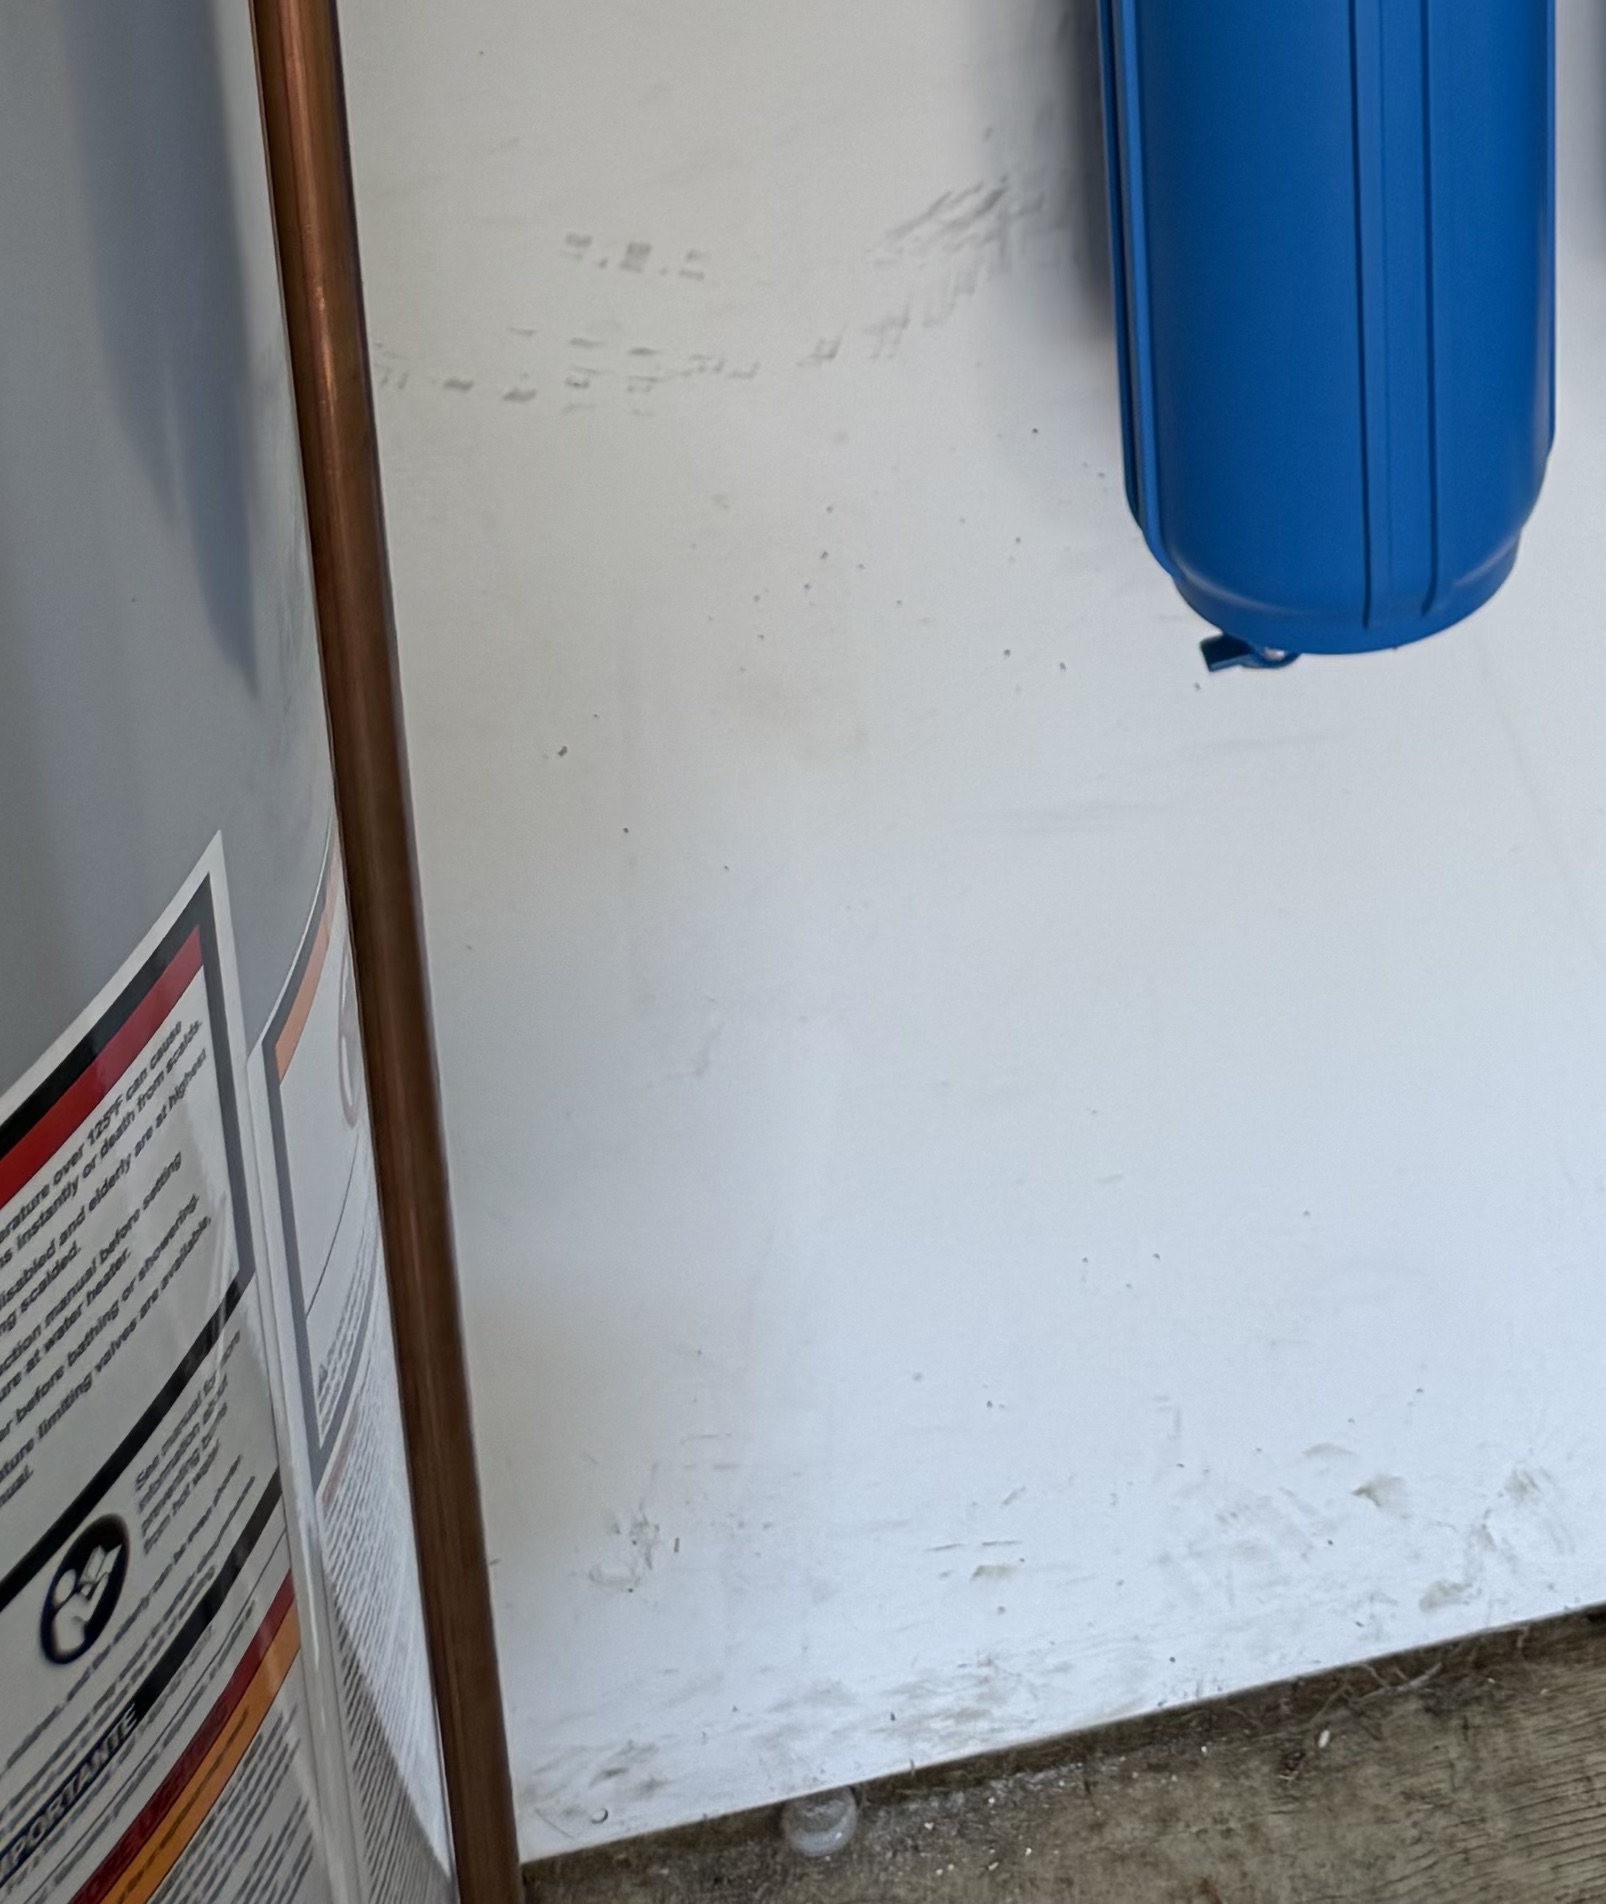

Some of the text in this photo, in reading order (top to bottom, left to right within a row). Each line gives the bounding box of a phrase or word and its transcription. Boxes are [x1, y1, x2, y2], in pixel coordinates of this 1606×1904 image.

[17, 1175, 79, 1249] instantly
[83, 1158, 98, 1179] or
[100, 1110, 136, 1160] death
[138, 1070, 165, 1113] from
[53, 1143, 85, 1186] over
[87, 1094, 122, 1146] 125°F
[126, 1068, 147, 1101] can
[150, 1020, 182, 1069] cause
[59, 1206, 86, 1248] and
[89, 1153, 132, 1211] elderly
[135, 1126, 153, 1158] are
[156, 1106, 168, 1128] at
[168, 1048, 207, 1111] highest
[16, 1365, 64, 1425] before
[67, 1299, 120, 1369] bathing
[121, 1278, 136, 1302] or
[138, 1194, 200, 1281] showering.
[20, 1241, 81, 1313] scalded.
[24, 1349, 42, 1374] at
[44, 1303, 83, 1353] water
[86, 1248, 131, 1306] heater.
[45, 1257, 98, 1328] manual
[99, 1208, 141, 1264] before
[143, 1151, 182, 1210] setting
[37, 1370, 93, 1442] limiting
[94, 1317, 137, 1373] valves
[140, 1288, 160, 1320] are
